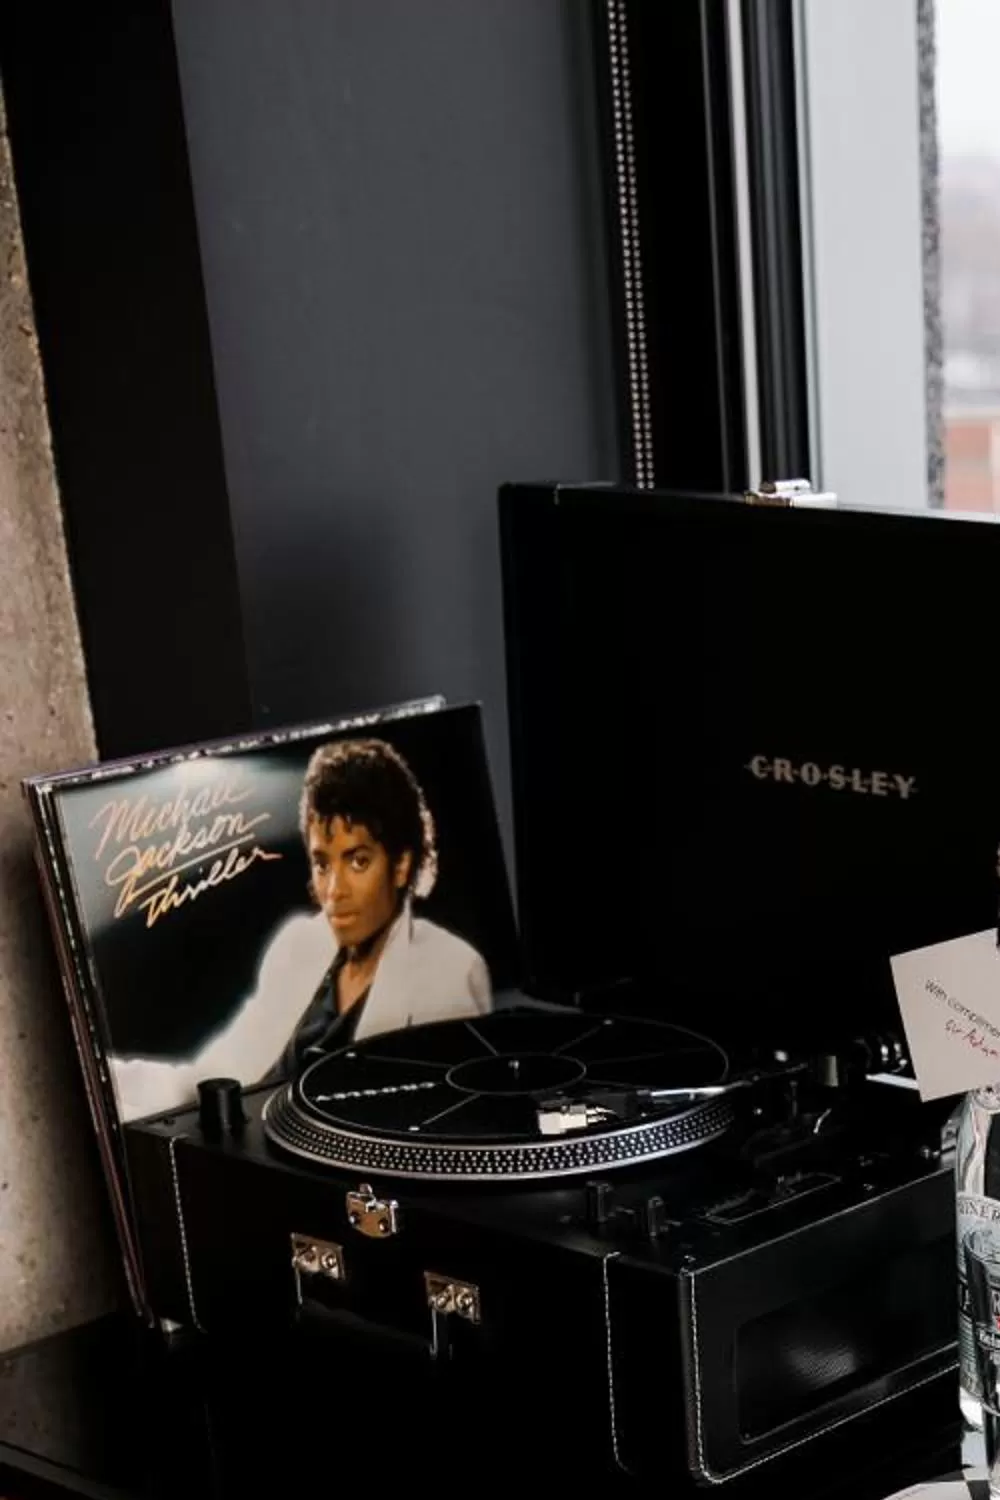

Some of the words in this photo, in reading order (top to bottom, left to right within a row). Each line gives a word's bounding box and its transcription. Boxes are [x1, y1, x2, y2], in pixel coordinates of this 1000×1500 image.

[748, 755, 917, 799] CROSLEY
[105, 812, 272, 918] Jackson
[138, 846, 283, 928] Thriller
